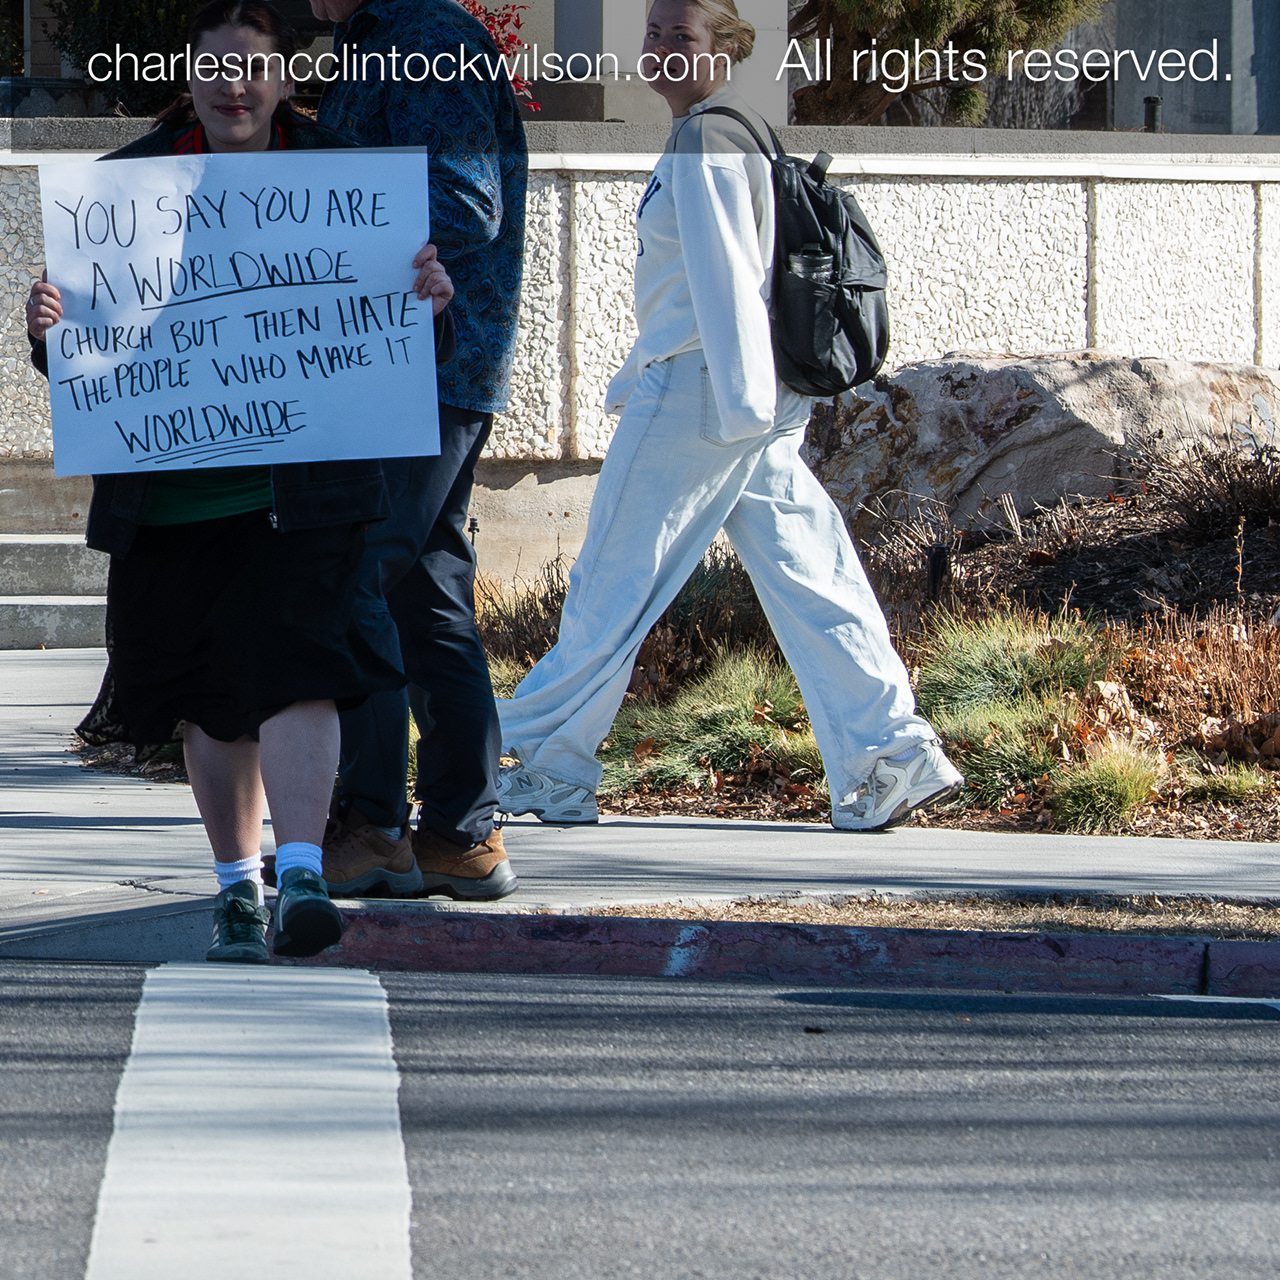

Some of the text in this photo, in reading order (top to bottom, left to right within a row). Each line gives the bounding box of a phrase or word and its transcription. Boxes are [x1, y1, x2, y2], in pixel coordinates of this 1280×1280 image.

[55, 185, 391, 250] YOU SAY YOU ARE
[91, 246, 355, 311] A WORLDWIDE
[60, 291, 419, 360] CHURCH BUT THEN HATE
[58, 336, 412, 412] THE PEOPLE WHO MAKE IT
[114, 398, 308, 455] WORLDWIDE
